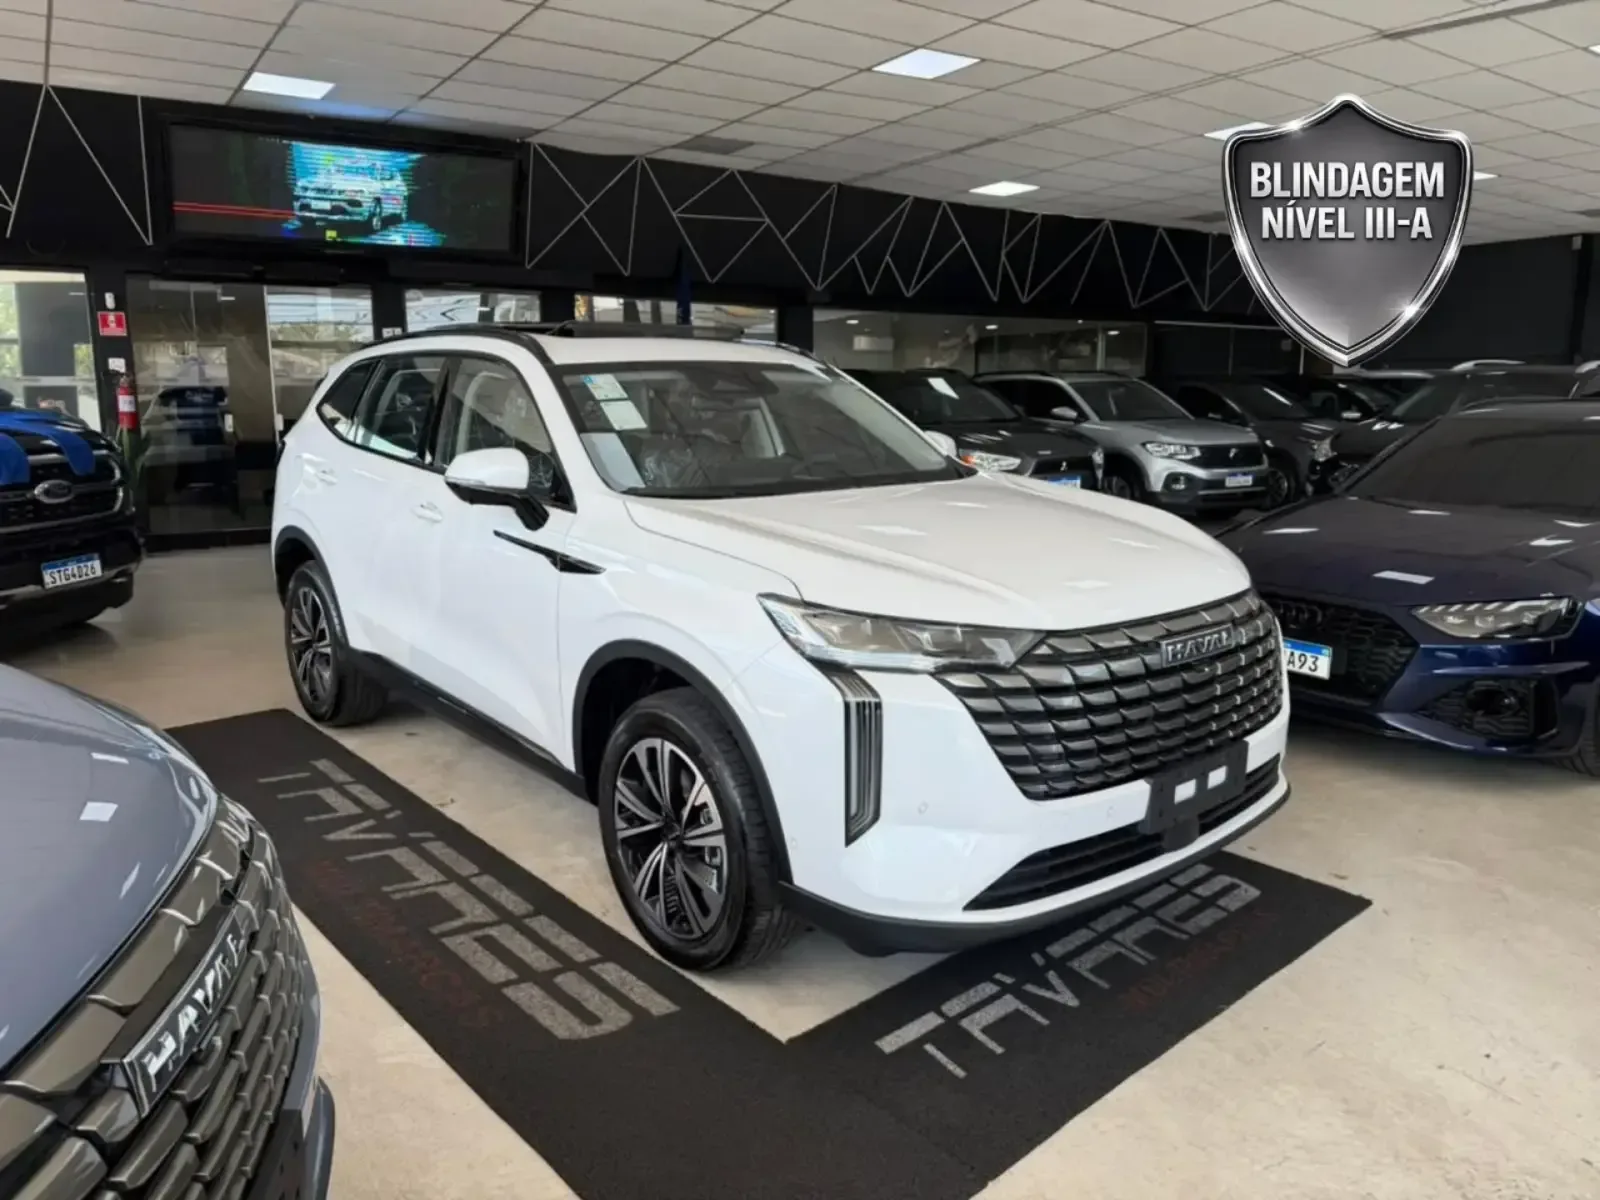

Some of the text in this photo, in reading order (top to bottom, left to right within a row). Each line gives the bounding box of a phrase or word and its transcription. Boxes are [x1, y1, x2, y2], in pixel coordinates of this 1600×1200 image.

[1166, 630, 1230, 662] HAVAL
[1284, 650, 1320, 673] A93
[874, 863, 1262, 1079] TAVARES
